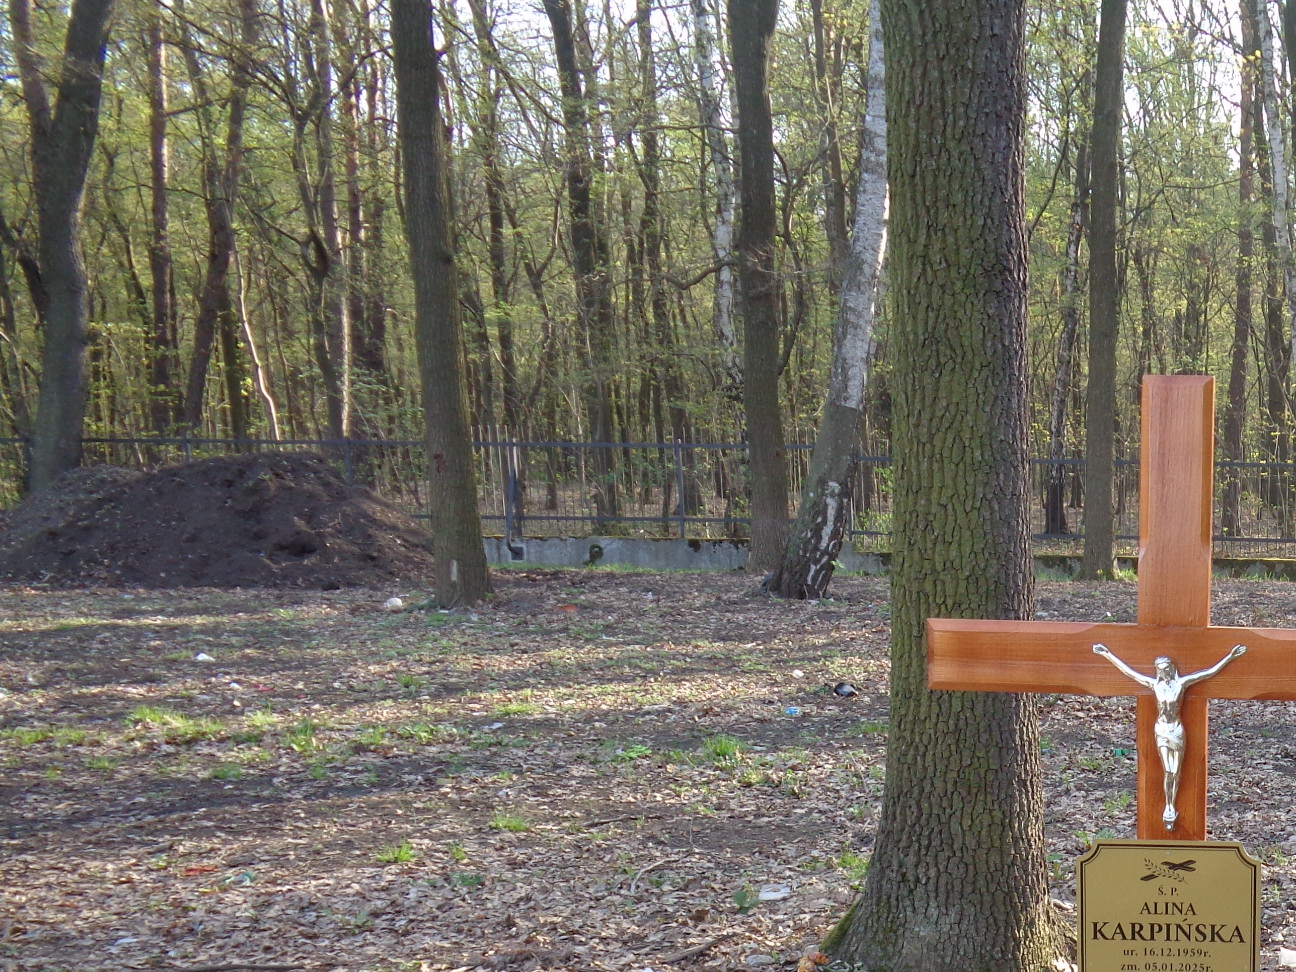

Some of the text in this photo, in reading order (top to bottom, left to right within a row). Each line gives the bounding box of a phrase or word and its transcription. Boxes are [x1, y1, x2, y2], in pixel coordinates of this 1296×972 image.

[1170, 887, 1179, 897] P.
[1139, 902, 1197, 916] ALINA
[1091, 918, 1247, 944] KARPIŃSKA
[1122, 947, 1212, 958] ur. 16.12.1959r.
[1120, 962, 1214, 972] zm. 05.01.2025r.
